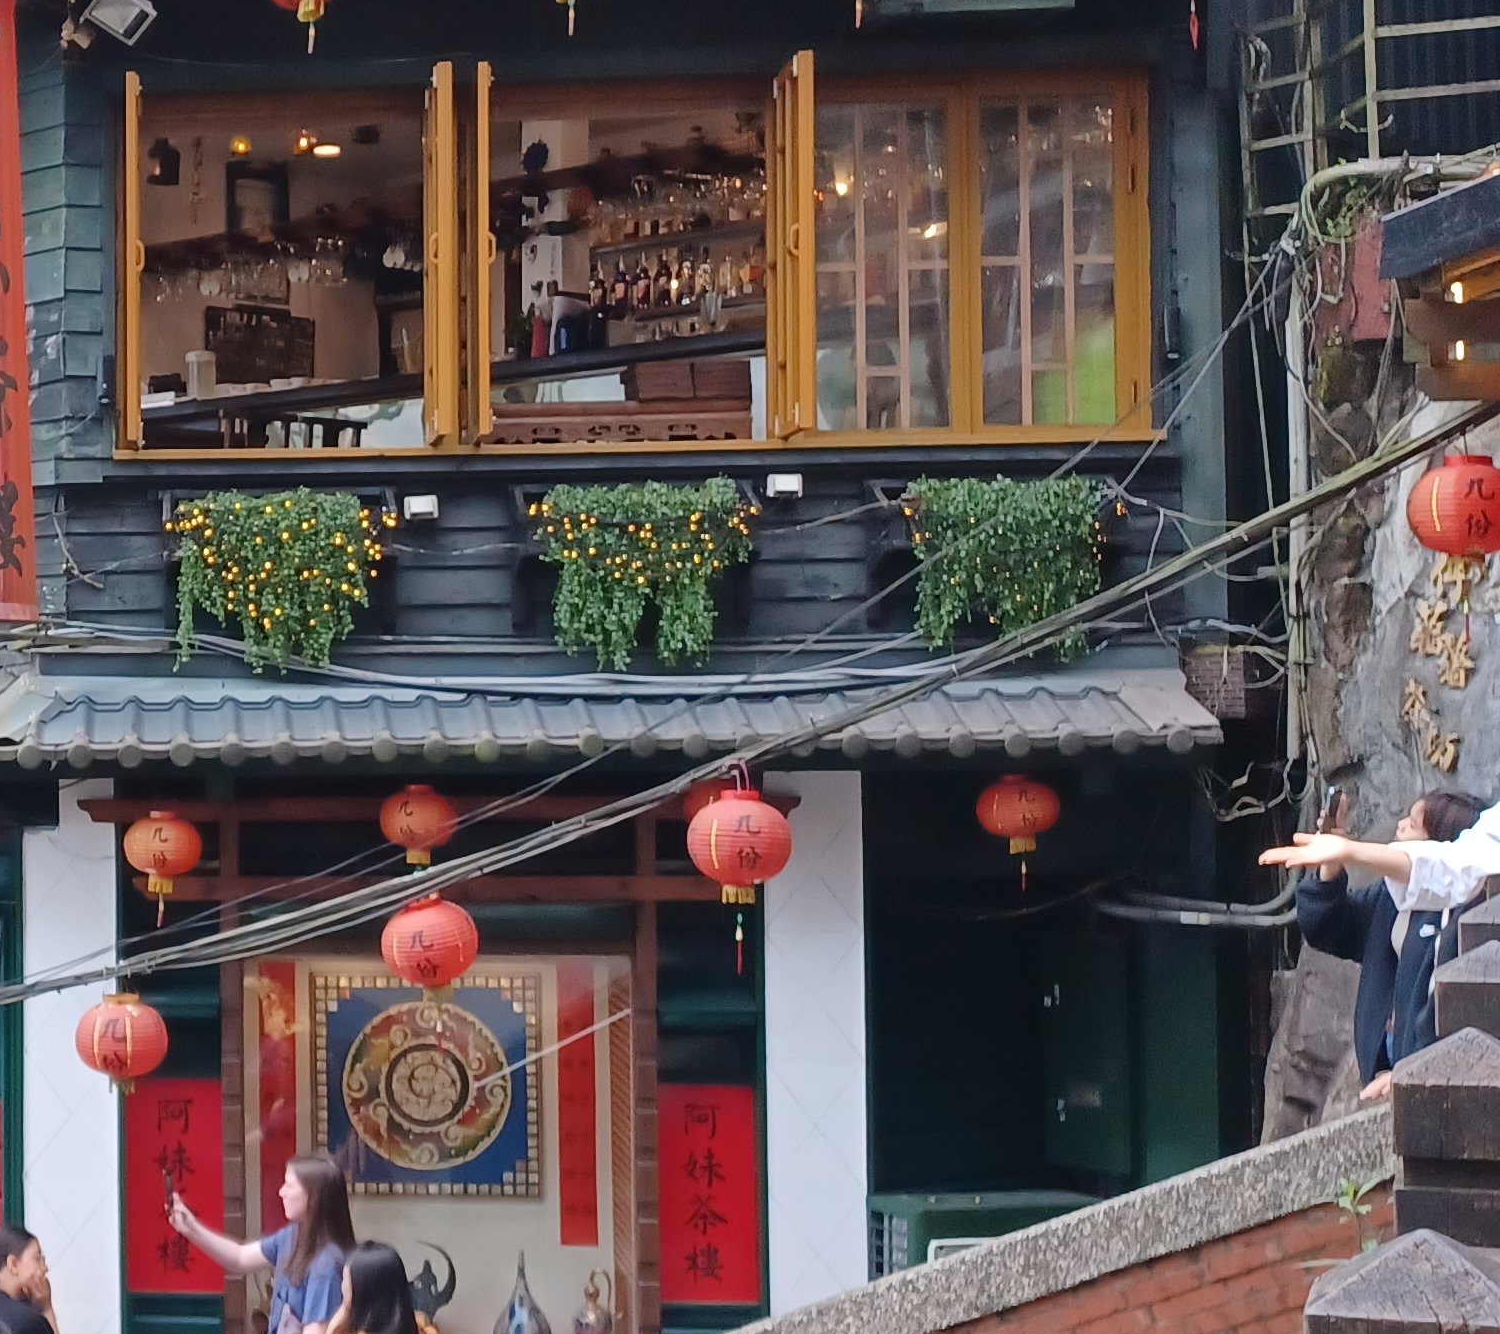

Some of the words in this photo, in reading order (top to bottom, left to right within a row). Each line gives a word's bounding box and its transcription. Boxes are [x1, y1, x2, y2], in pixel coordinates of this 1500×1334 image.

[153, 1099, 195, 1274] 阿妹樓
[682, 1103, 728, 1283] 阿妹茶樓
